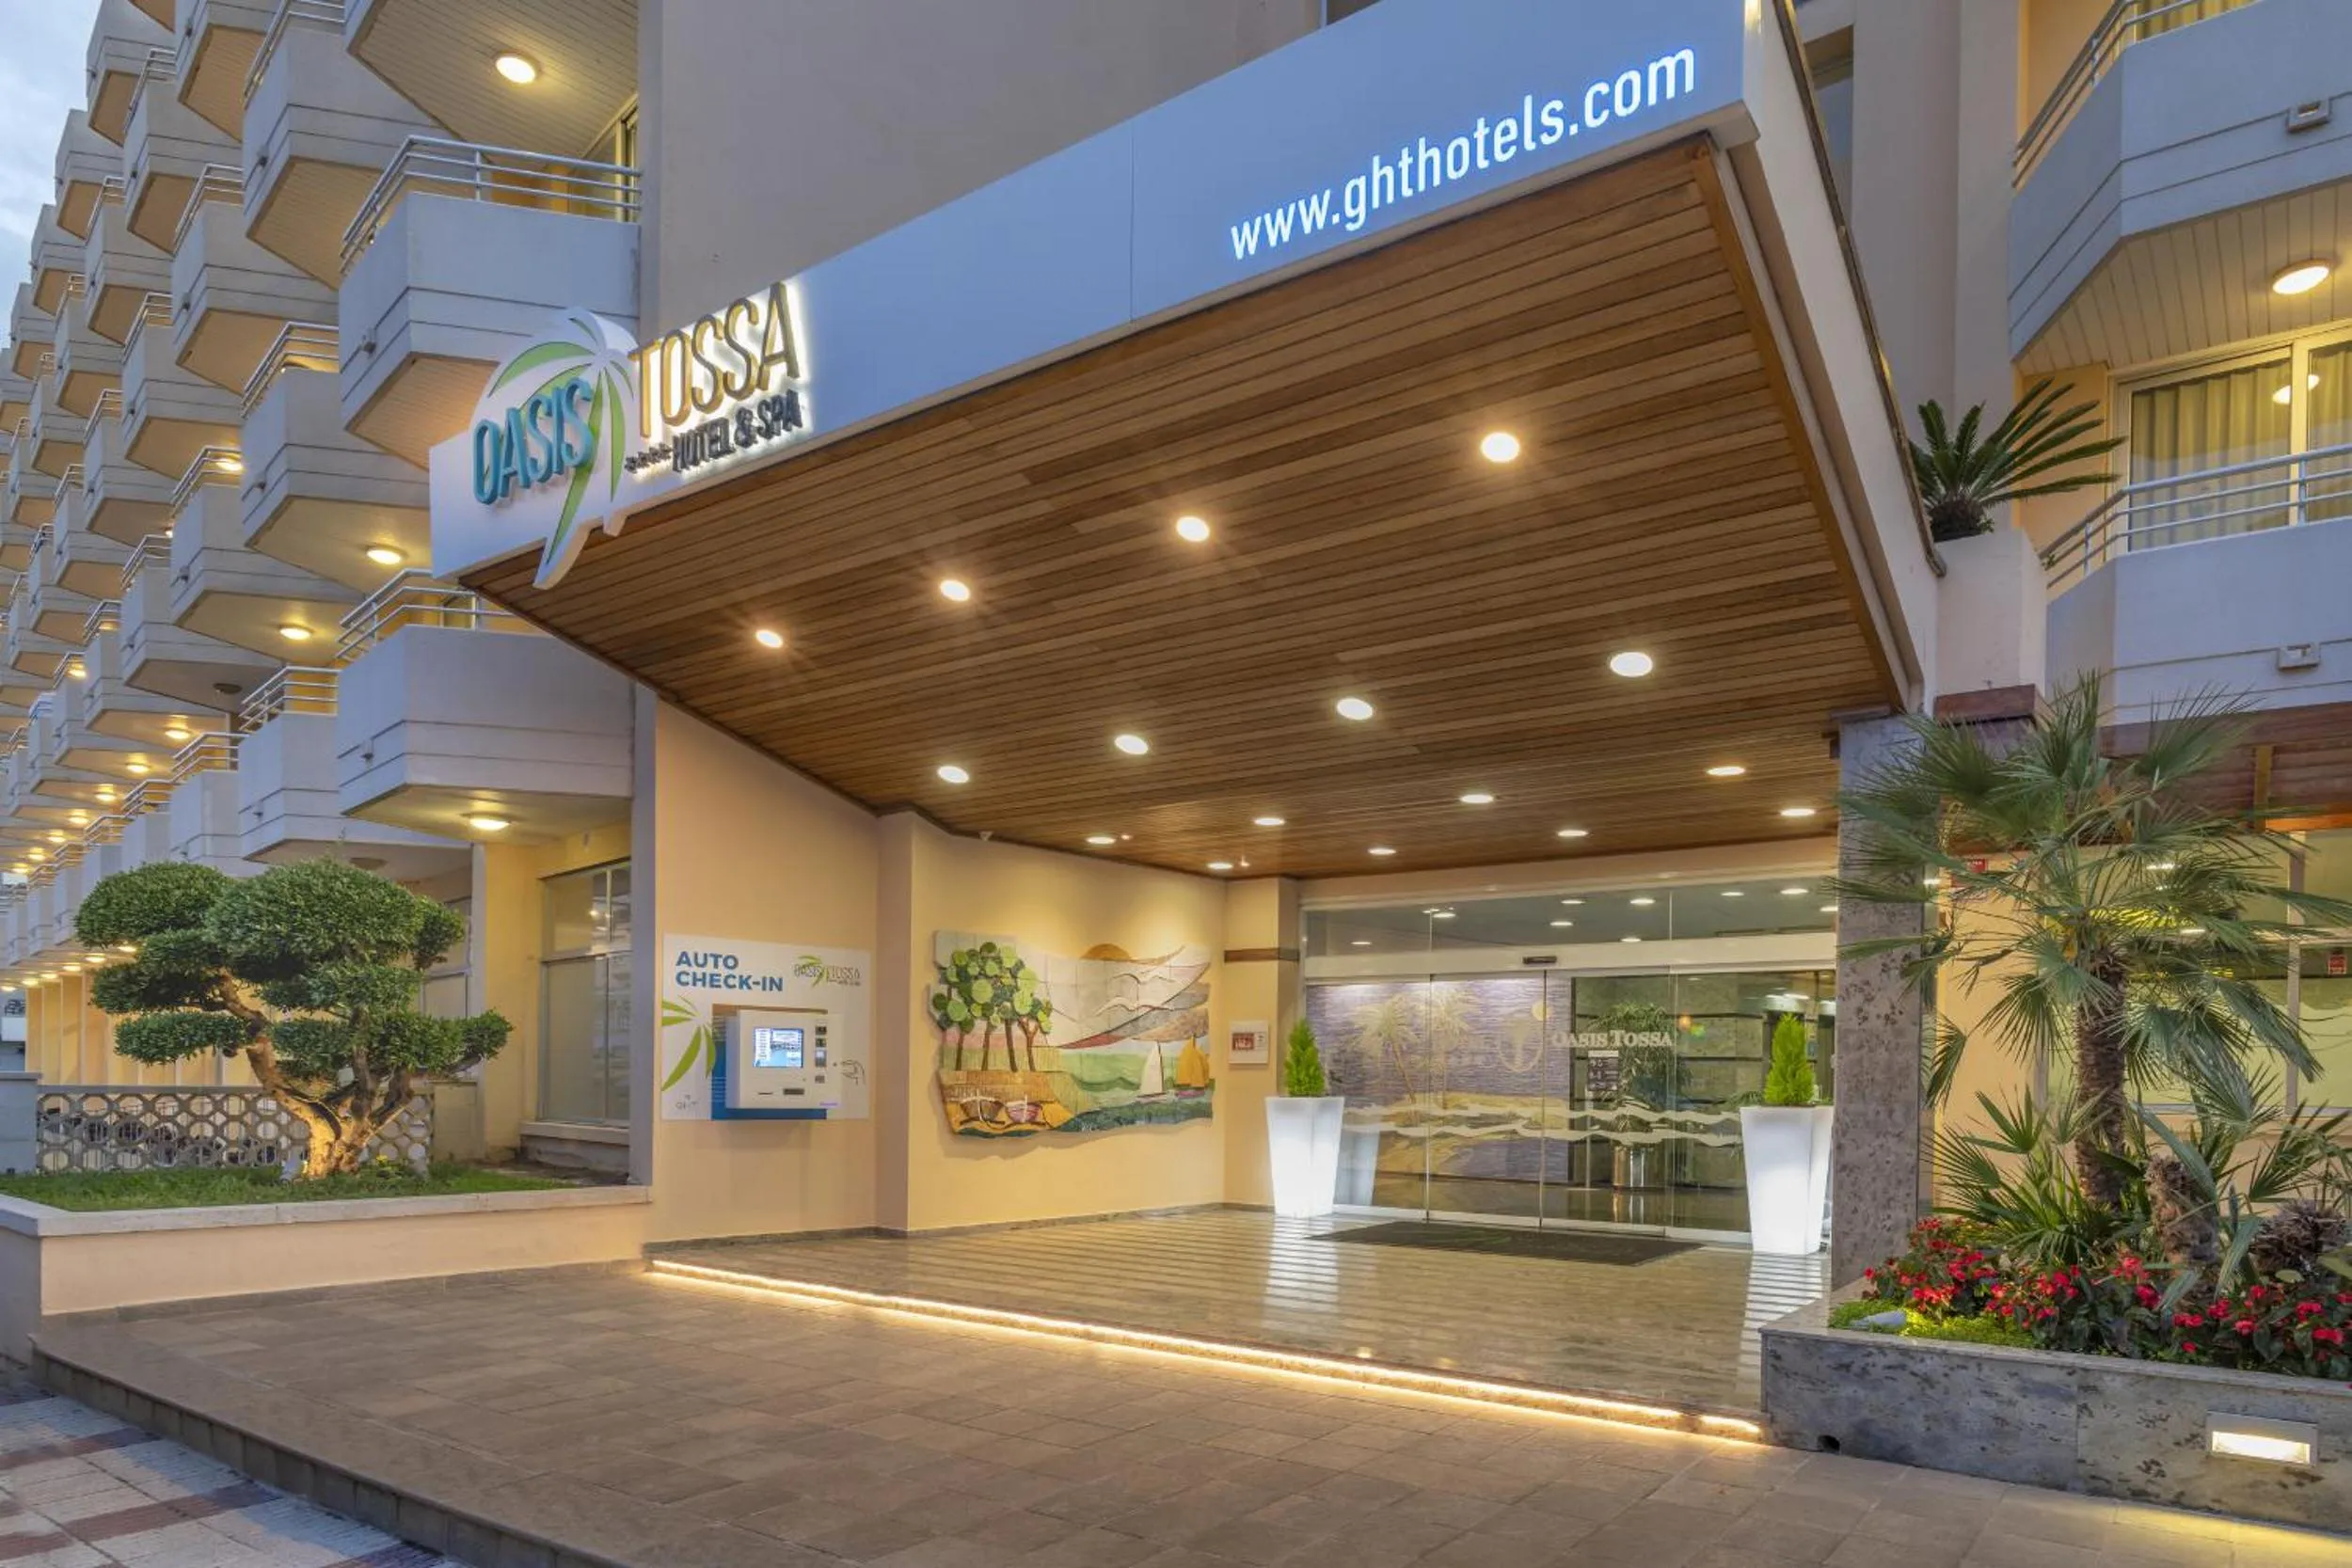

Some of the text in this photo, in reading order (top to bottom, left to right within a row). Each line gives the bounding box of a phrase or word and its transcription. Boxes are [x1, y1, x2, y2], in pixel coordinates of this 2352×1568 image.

[1231, 48, 1695, 260] www.ghthotels.com
[472, 281, 801, 506] OASIS TOSSA
[673, 417, 736, 472] HOTEL
[756, 388, 803, 440] SPA
[675, 950, 739, 970] AUTO
[675, 971, 784, 991] CHECK-IN
